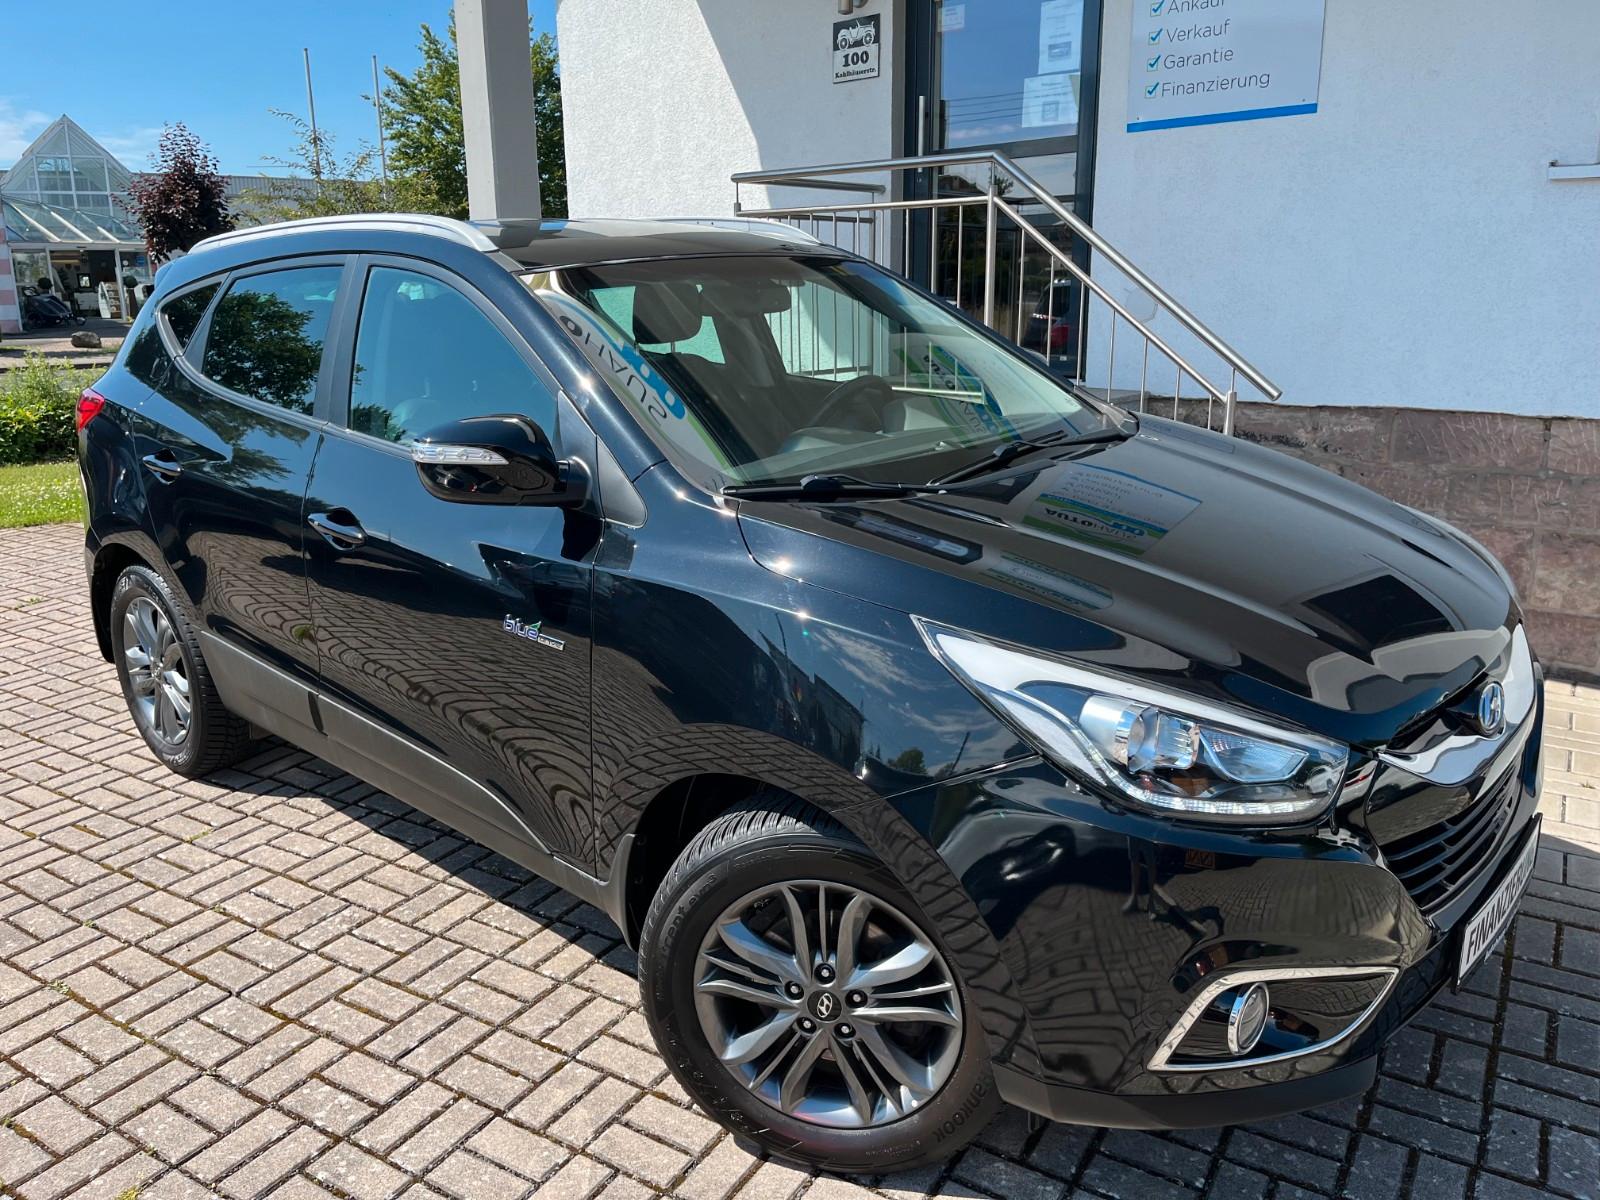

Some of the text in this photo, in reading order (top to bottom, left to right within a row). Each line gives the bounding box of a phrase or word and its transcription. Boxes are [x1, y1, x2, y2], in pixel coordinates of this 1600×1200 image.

[1166, 18, 1231, 43] Verkauf
[842, 50, 870, 67] 100
[1163, 47, 1234, 70] Garantie
[1161, 72, 1271, 97] Finanzierung
[503, 613, 539, 641] blue
